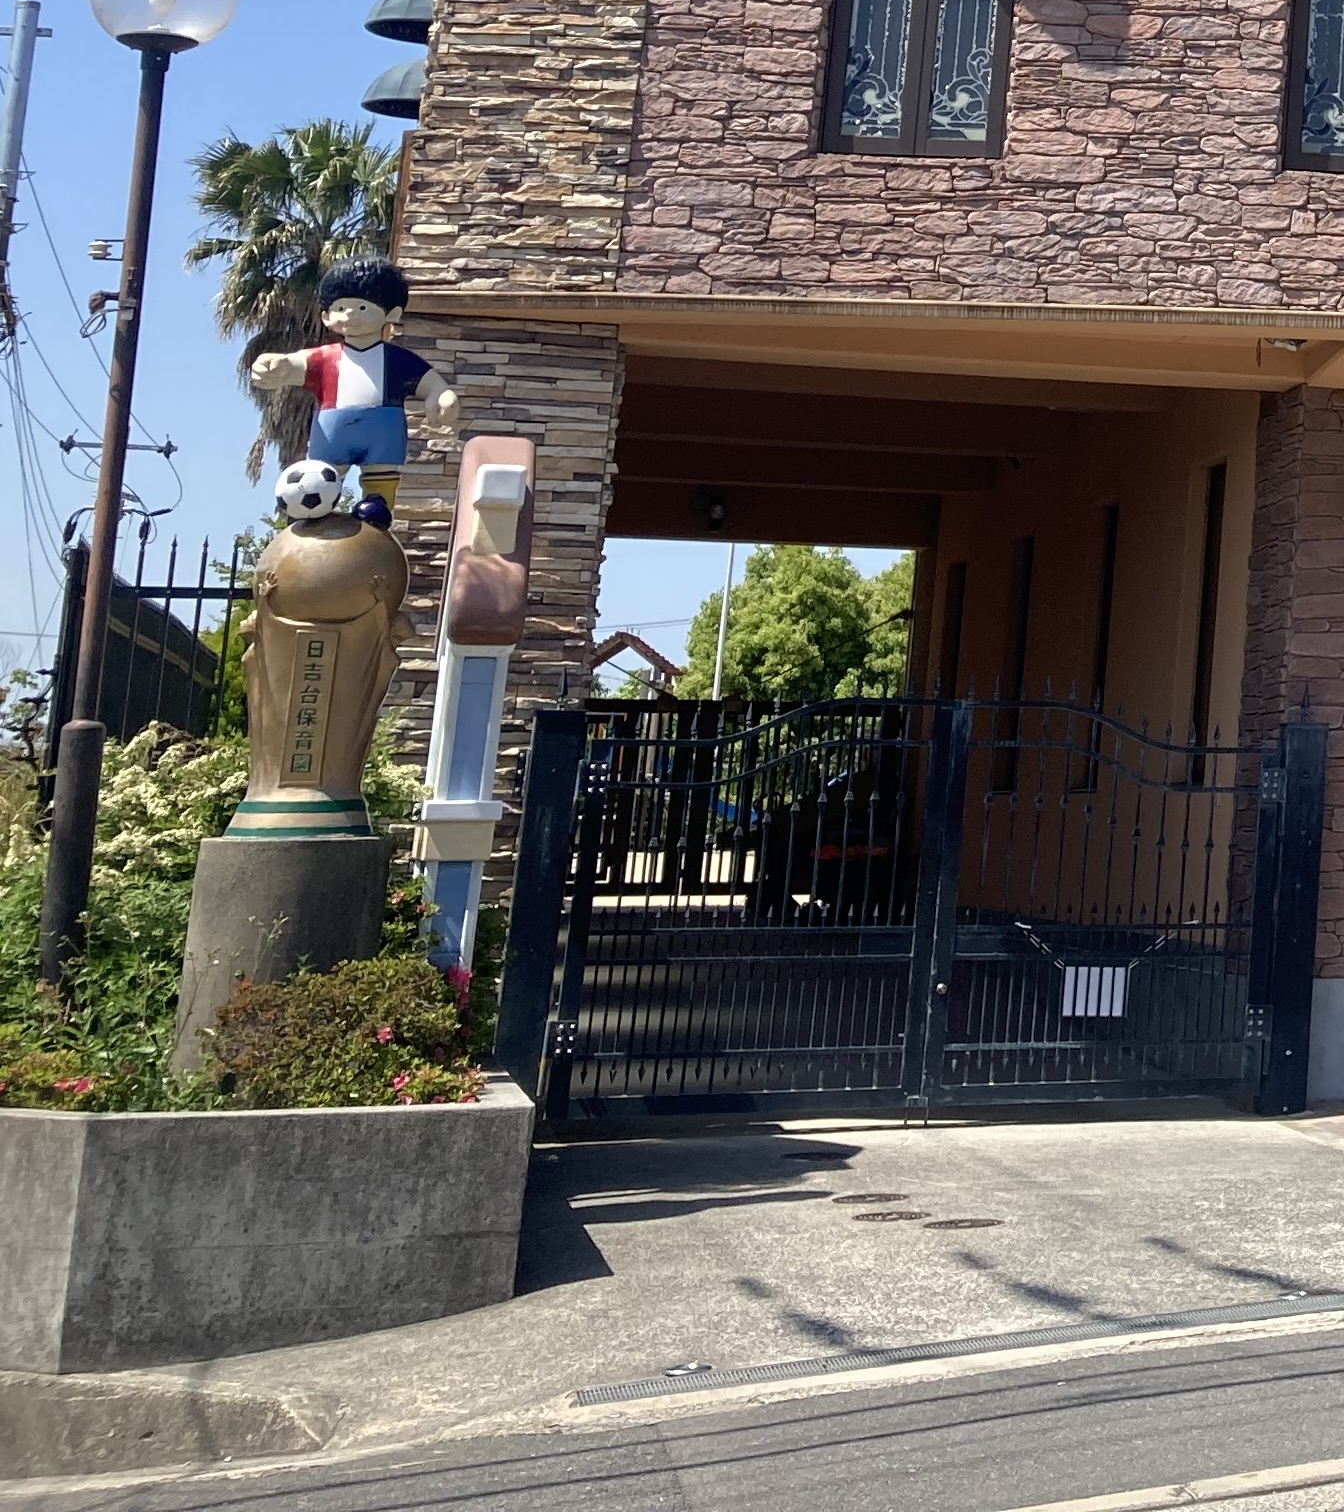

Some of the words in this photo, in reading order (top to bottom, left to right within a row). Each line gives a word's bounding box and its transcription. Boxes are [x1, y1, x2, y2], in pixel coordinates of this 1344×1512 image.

[290, 640, 324, 774] 日吉台保育園
